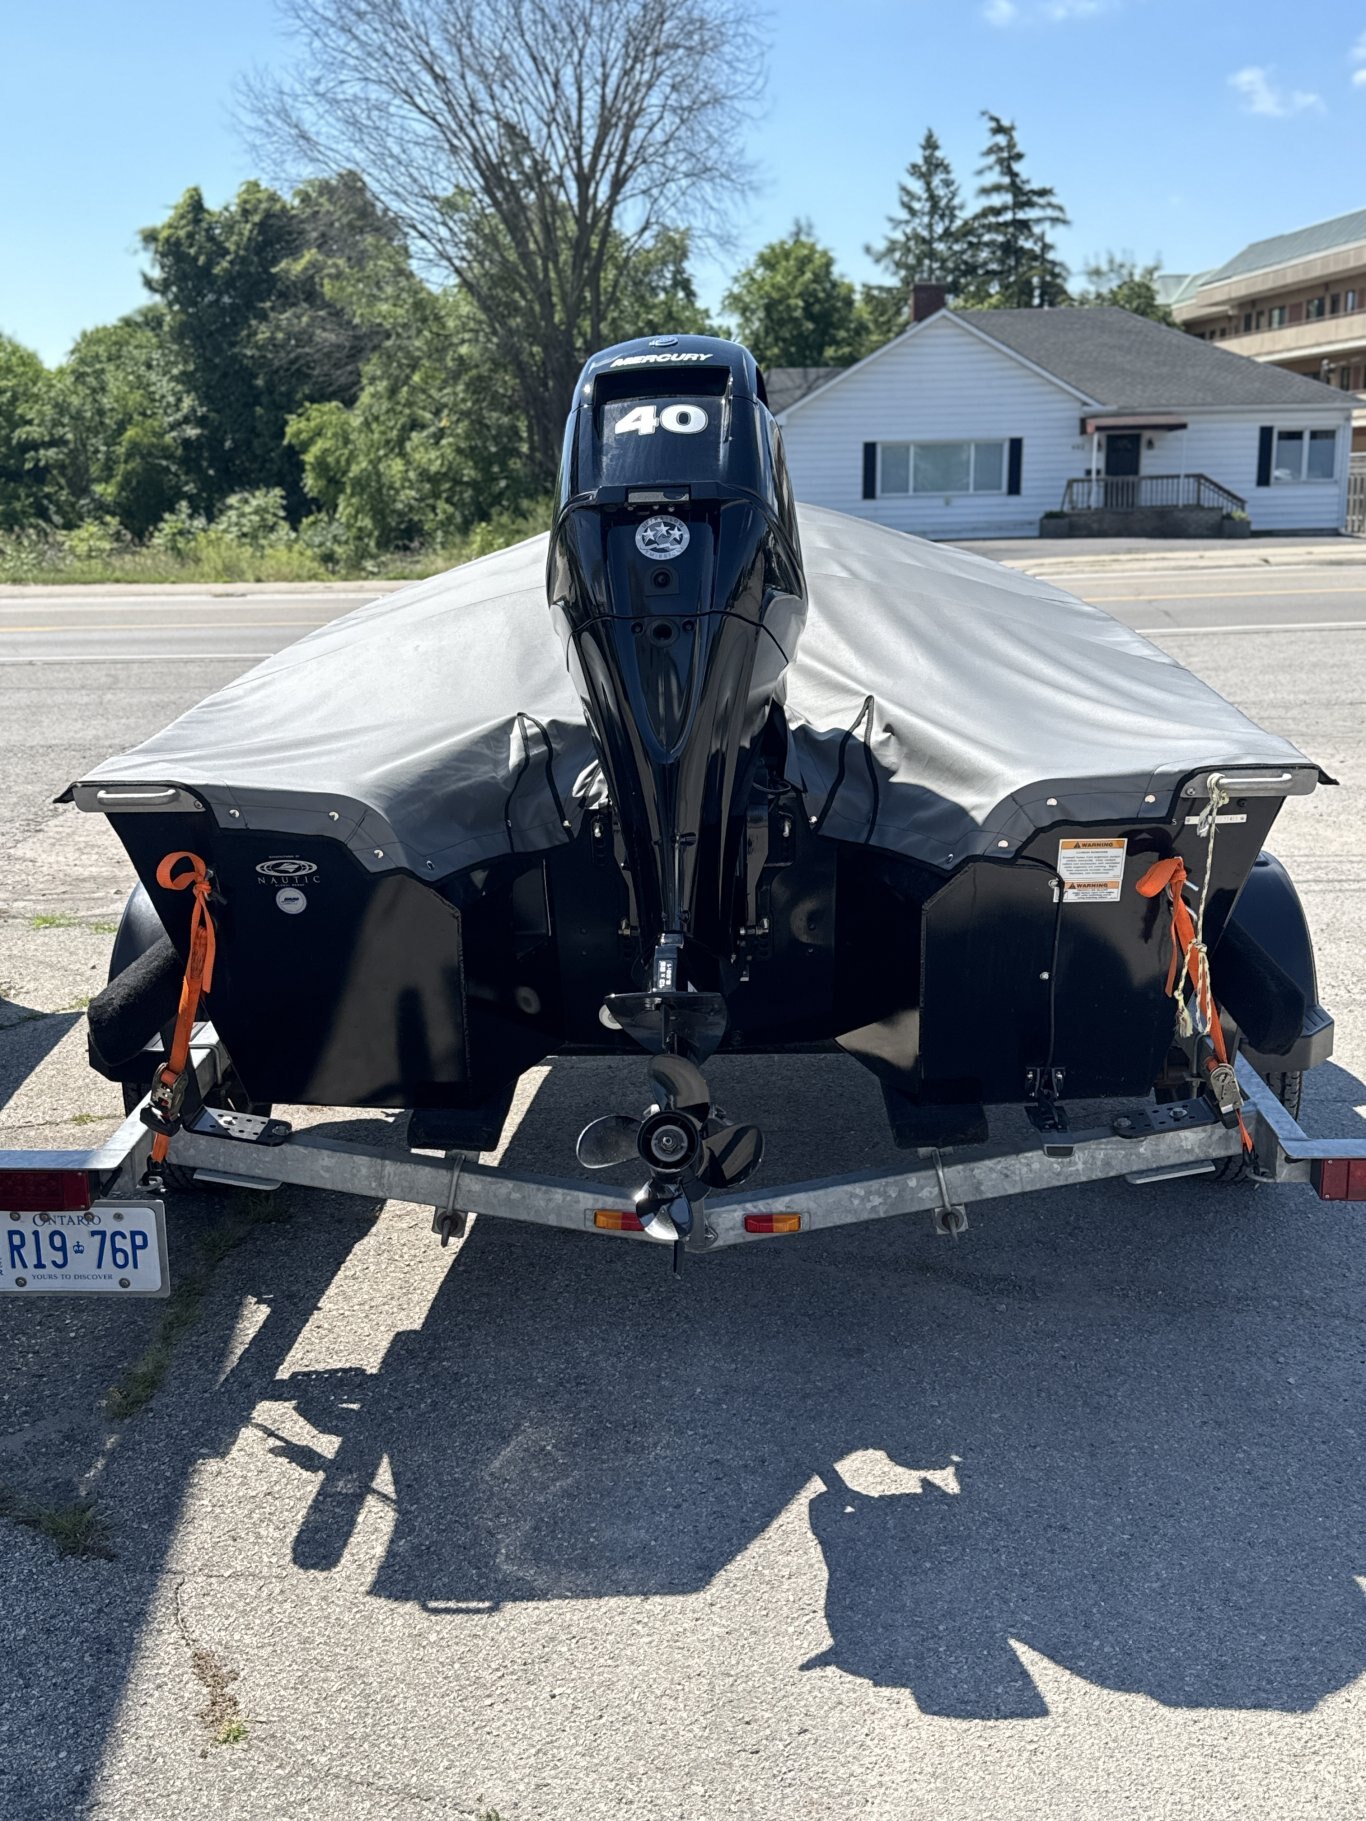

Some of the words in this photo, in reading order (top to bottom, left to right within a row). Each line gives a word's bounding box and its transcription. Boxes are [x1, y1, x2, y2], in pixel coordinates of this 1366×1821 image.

[610, 353, 714, 368] MERCURY
[614, 404, 709, 436] 40
[257, 875, 321, 885] NAUTIC
[7, 1229, 69, 1269] R19
[90, 1230, 149, 1269] 76P
